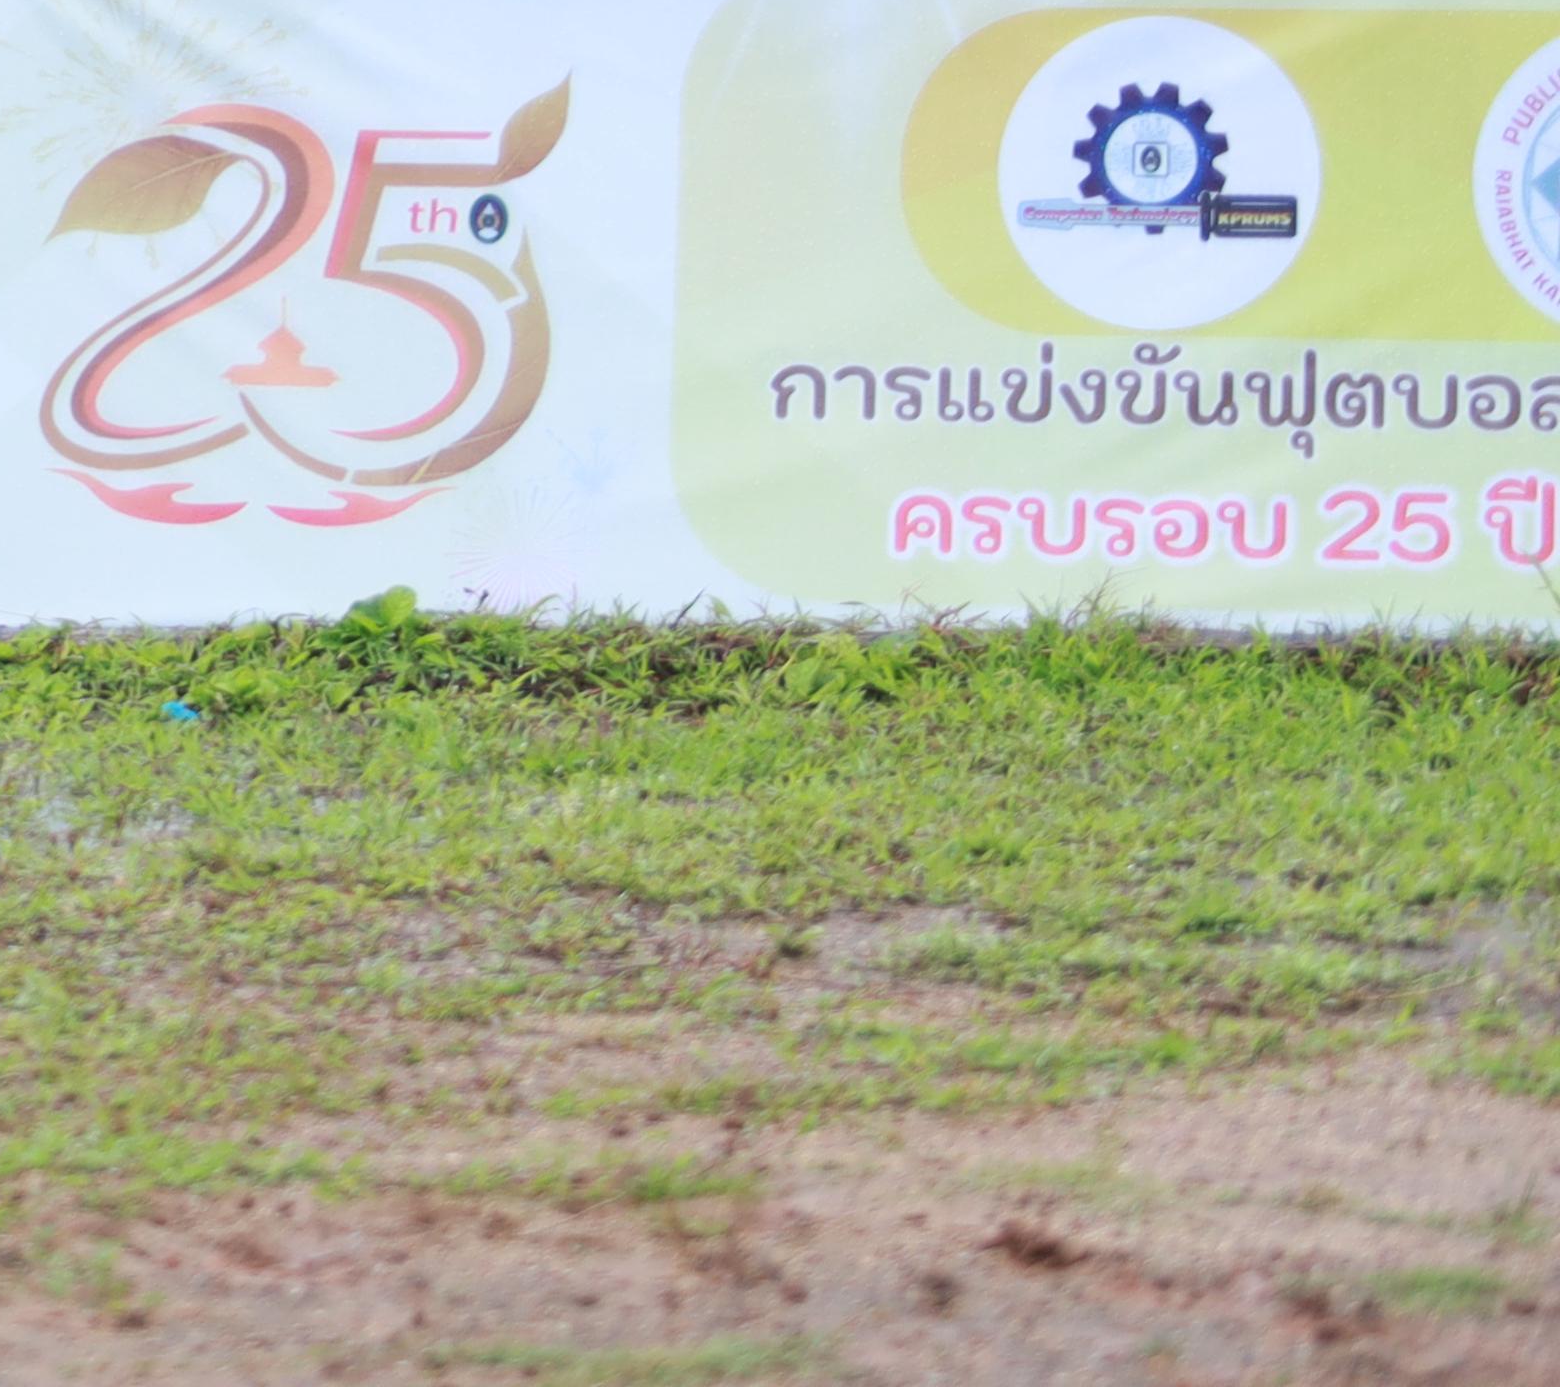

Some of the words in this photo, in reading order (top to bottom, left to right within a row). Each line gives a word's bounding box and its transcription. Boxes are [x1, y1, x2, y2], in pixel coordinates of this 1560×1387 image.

[1501, 68, 1560, 146] PUBLI
[408, 198, 458, 234] th
[1023, 205, 1102, 224] Computer
[1107, 206, 1199, 226] Technology
[893, 493, 1287, 559] ครบรอบ
[1322, 491, 1450, 563] 25
